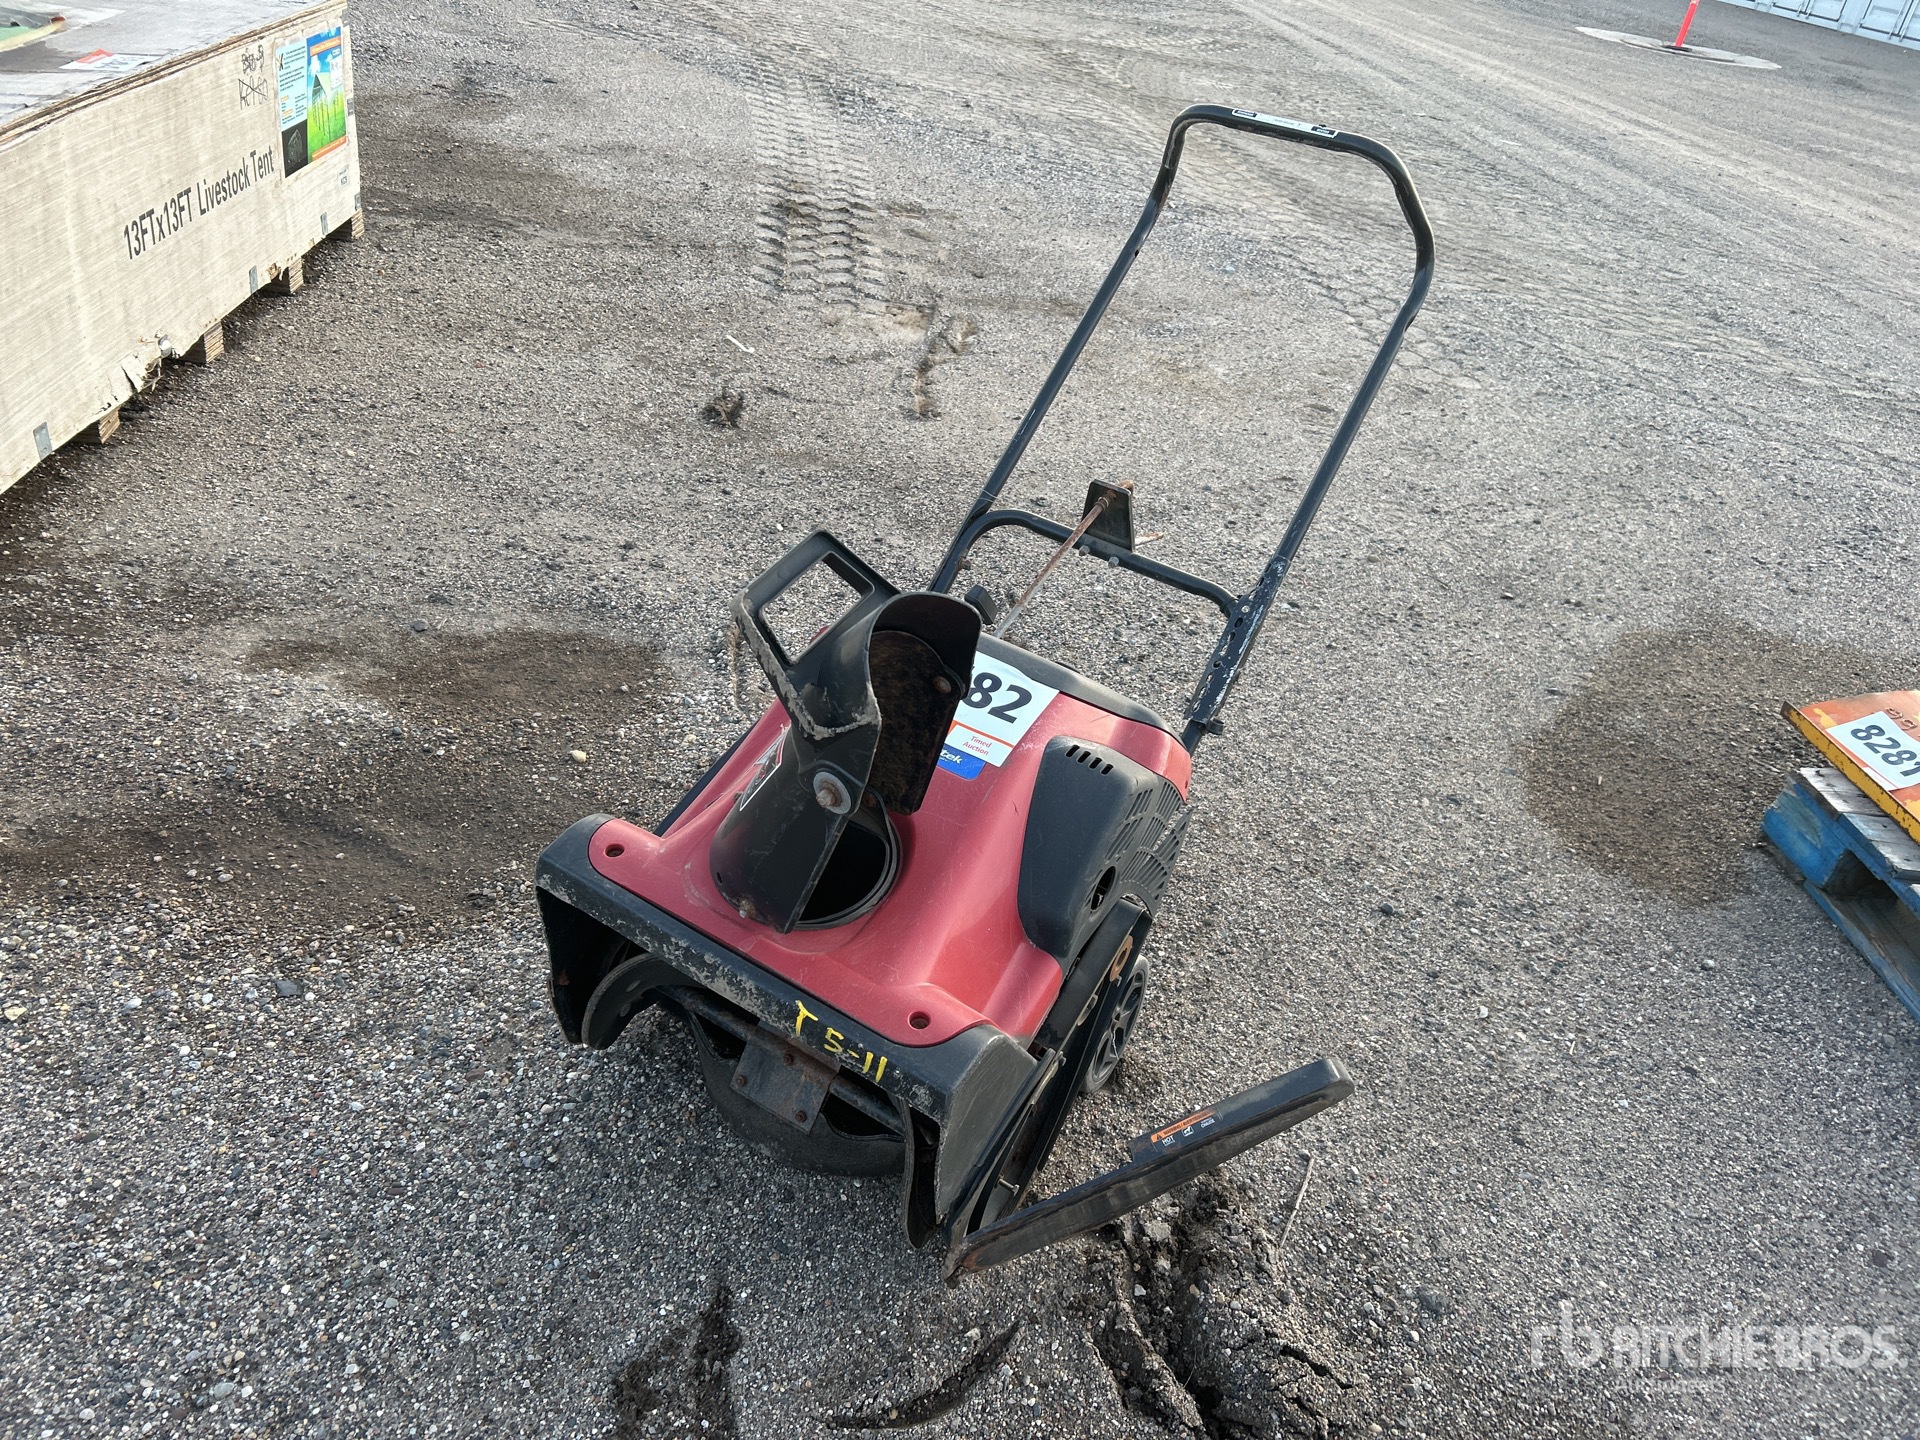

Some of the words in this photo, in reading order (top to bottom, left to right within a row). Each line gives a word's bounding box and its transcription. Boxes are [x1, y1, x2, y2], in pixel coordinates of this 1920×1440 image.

[123, 186, 193, 260] 13FTx13FT
[196, 157, 251, 216] Livestock
[249, 145, 275, 183] Tent
[961, 671, 1033, 724] 82
[963, 741, 989, 756] Auction
[970, 735, 993, 749] Timed
[939, 749, 963, 765] tek
[1162, 1135, 1175, 1145] HOT
